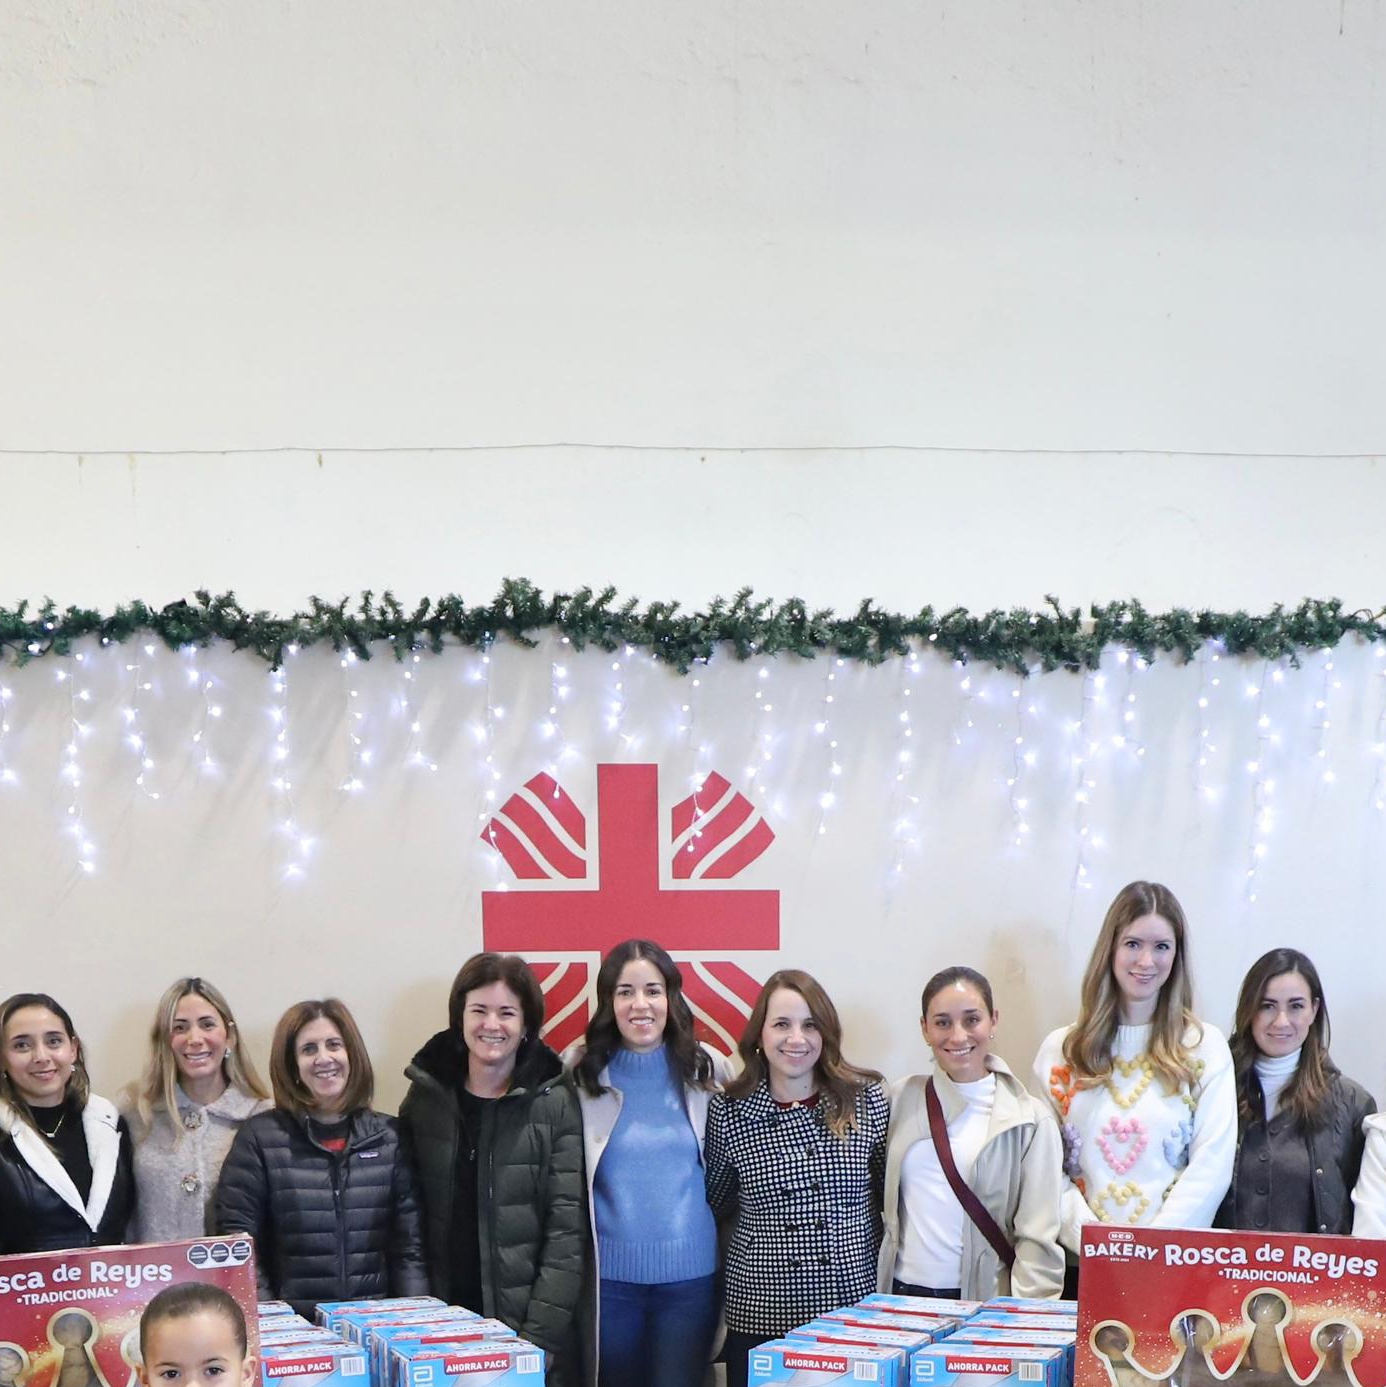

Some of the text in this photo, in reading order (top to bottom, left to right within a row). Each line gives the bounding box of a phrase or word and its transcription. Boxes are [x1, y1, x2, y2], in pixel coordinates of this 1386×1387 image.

[1084, 1242, 1159, 1261] BAKERY
[1164, 1244, 1248, 1266] Rosca
[1255, 1243, 1285, 1262] de
[1293, 1245, 1379, 1278] Reyes
[52, 1263, 82, 1283] de
[90, 1261, 173, 1288] Reyes
[268, 1361, 332, 1376] AHORRA PACK
[446, 1359, 508, 1373] AHORRA PACK
[785, 1358, 845, 1371] AHORRA PACK
[947, 1361, 1010, 1373] AHORRA PACK
